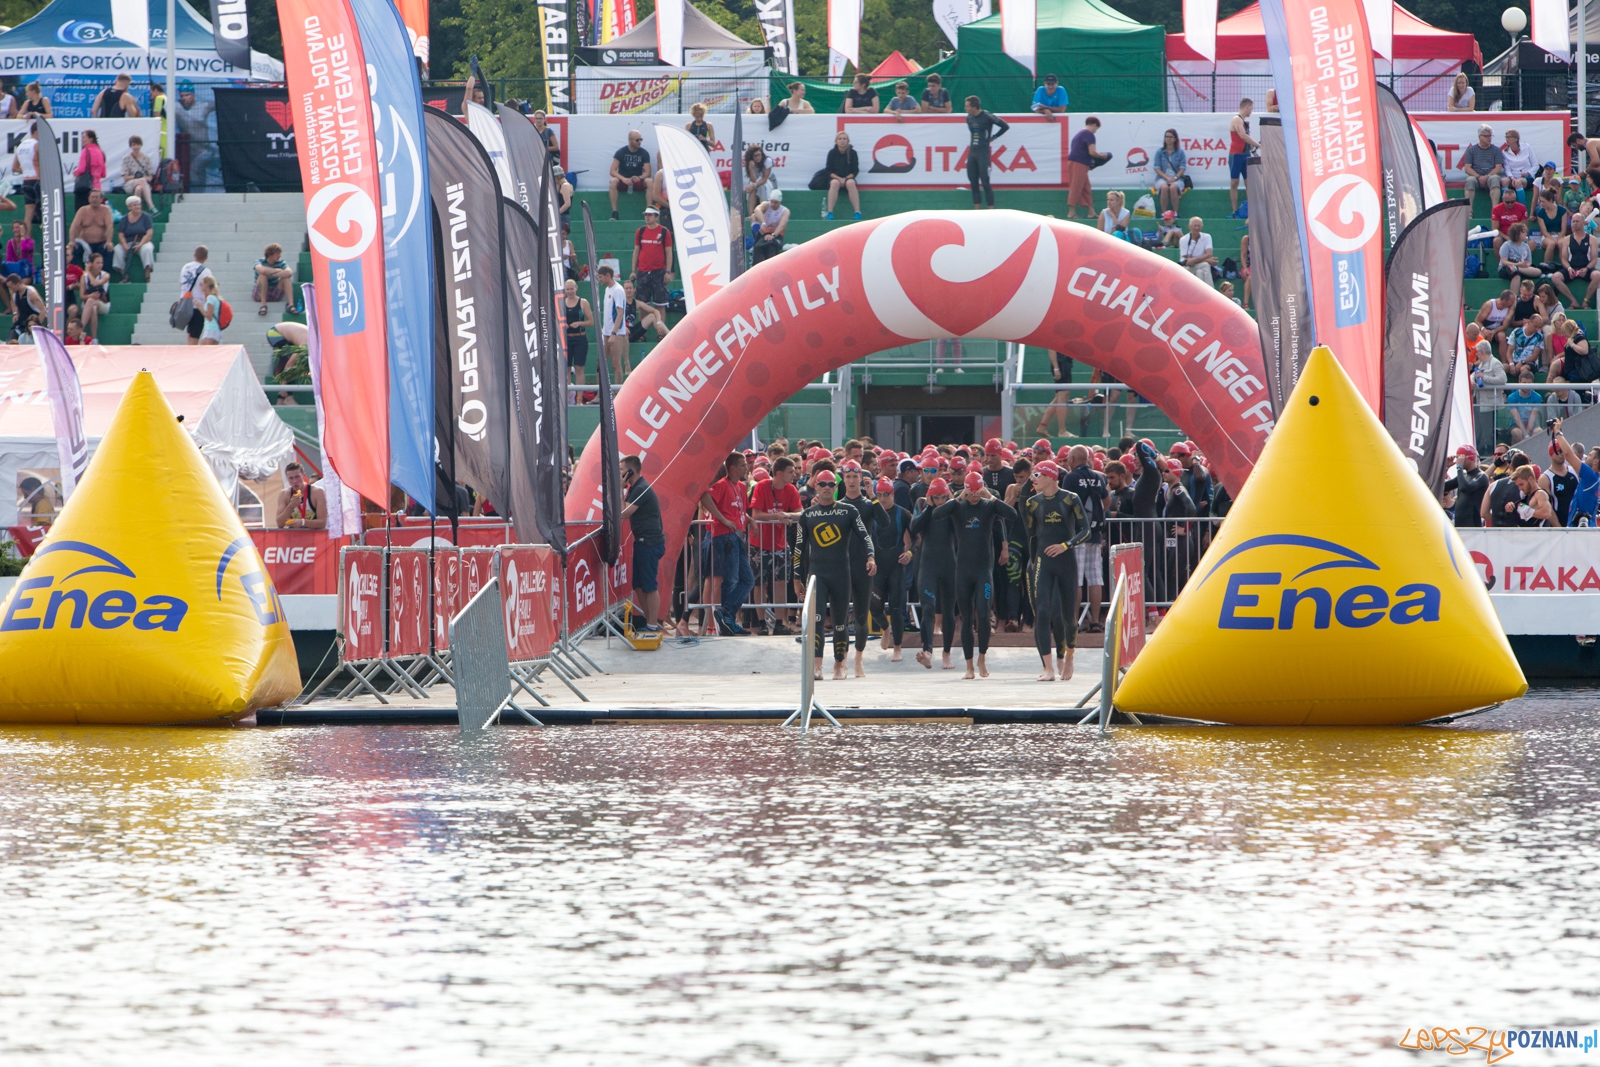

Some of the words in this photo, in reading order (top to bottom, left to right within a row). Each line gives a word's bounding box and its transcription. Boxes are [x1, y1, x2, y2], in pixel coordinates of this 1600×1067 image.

[61, 53, 141, 70] SPORTÓW
[1544, 51, 1600, 63] nelne
[54, 92, 86, 103] SKLEP
[599, 75, 670, 100] DEXTRO
[609, 83, 669, 114] ENERGY
[1126, 166, 1149, 174] ITAKA
[1187, 156, 1214, 170] czy
[1409, 361, 1432, 456] PEARL
[263, 546, 317, 564] ENGE
[1504, 565, 1600, 592] ITAKA
[0, 575, 188, 632] Enea
[576, 580, 596, 612] Enea
[1218, 571, 1441, 630] Enea
